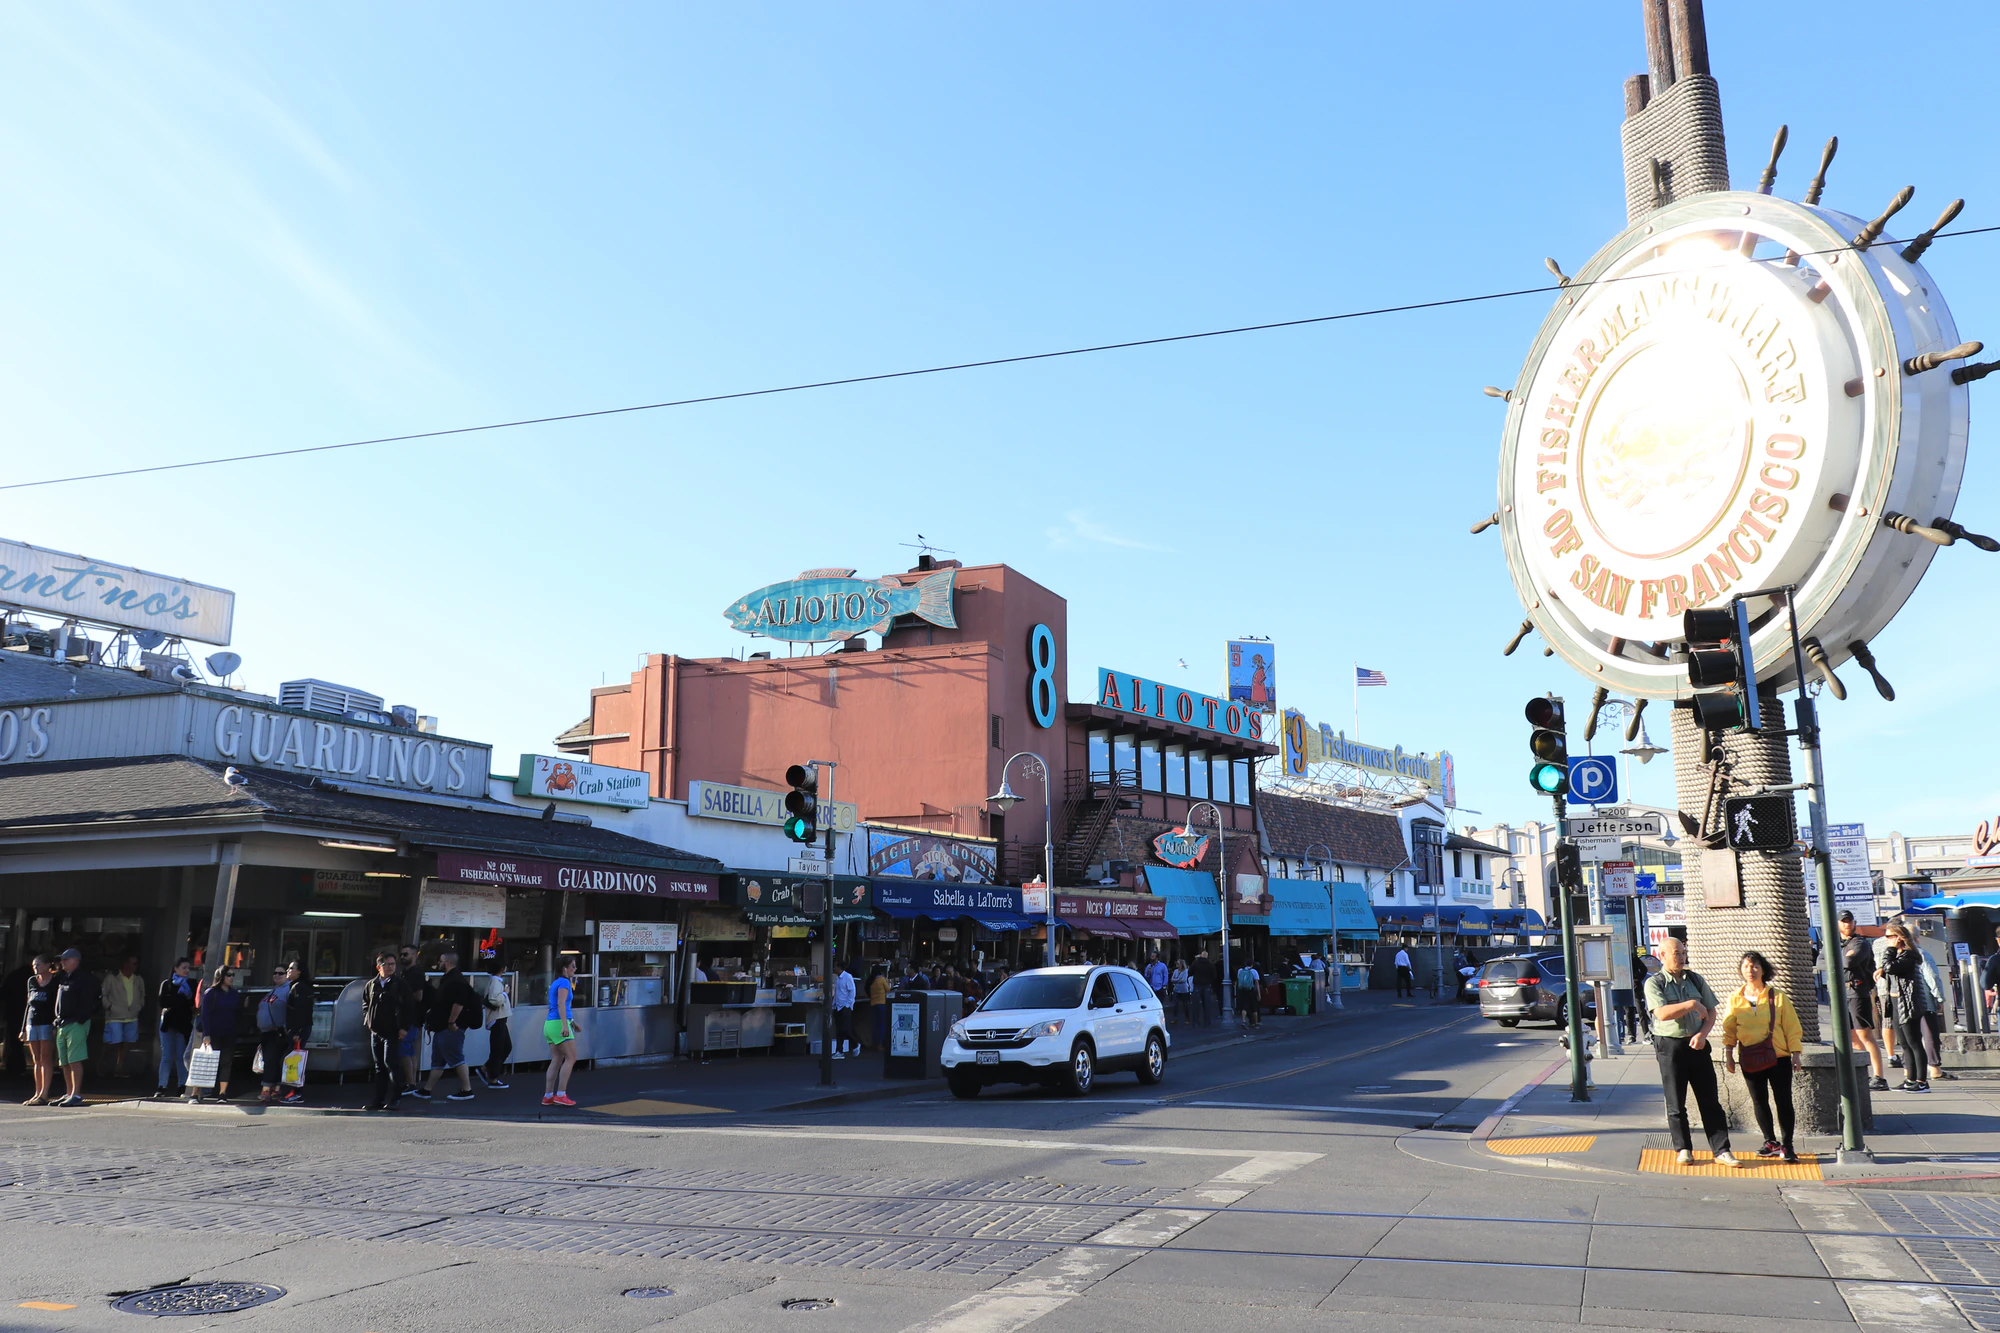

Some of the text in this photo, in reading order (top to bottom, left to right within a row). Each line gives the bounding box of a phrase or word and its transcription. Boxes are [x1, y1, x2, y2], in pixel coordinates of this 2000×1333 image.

[1536, 274, 1807, 495] FISHERMAN'S WHARF
[1543, 433, 1806, 620] OF SAN FRANCISCO
[754, 585, 892, 627] ALIOTO'S
[1232, 653, 1241, 667] 9
[1031, 623, 1057, 729] 8
[1101, 673, 1262, 740] ALIOTO'S
[214, 705, 467, 791] GUARDINO'S
[1291, 714, 1307, 774] 9
[1318, 721, 1394, 772] Fishermen's
[1394, 744, 1431, 780] Grotto
[536, 758, 549, 772] #2
[580, 766, 593, 776] THE
[579, 774, 641, 796] Crab Station
[607, 795, 647, 806] Fisherman's Wharf
[704, 788, 763, 817] SABELLA
[777, 799, 837, 825] LARRE
[1608, 808, 1626, 816] 200
[1577, 822, 1653, 834] Jefferson
[1842, 826, 1861, 835] Wharf
[870, 839, 921, 871] LIGHT
[923, 851, 953, 866] NICK'S
[951, 844, 996, 881] HOUSE
[500, 863, 517, 873] ONE
[798, 862, 820, 874] Taylor
[460, 868, 543, 886] FISHERMAN'S WHARF
[558, 867, 657, 894] GUARDINO'S
[670, 881, 692, 893] SINCE
[318, 881, 339, 892] gifts
[772, 885, 790, 902] Crab
[933, 889, 1013, 909] Sabella & LaTorre's
[1200, 896, 1216, 905] CAFE
[1086, 900, 1103, 915] NICK'S
[1112, 902, 1139, 916] LIGHTHOUSE
[601, 924, 620, 932] ORDER
[1238, 916, 1264, 924] ENTRANCE
[603, 932, 618, 940] HERE
[621, 937, 660, 946] BREAD BOWLS
